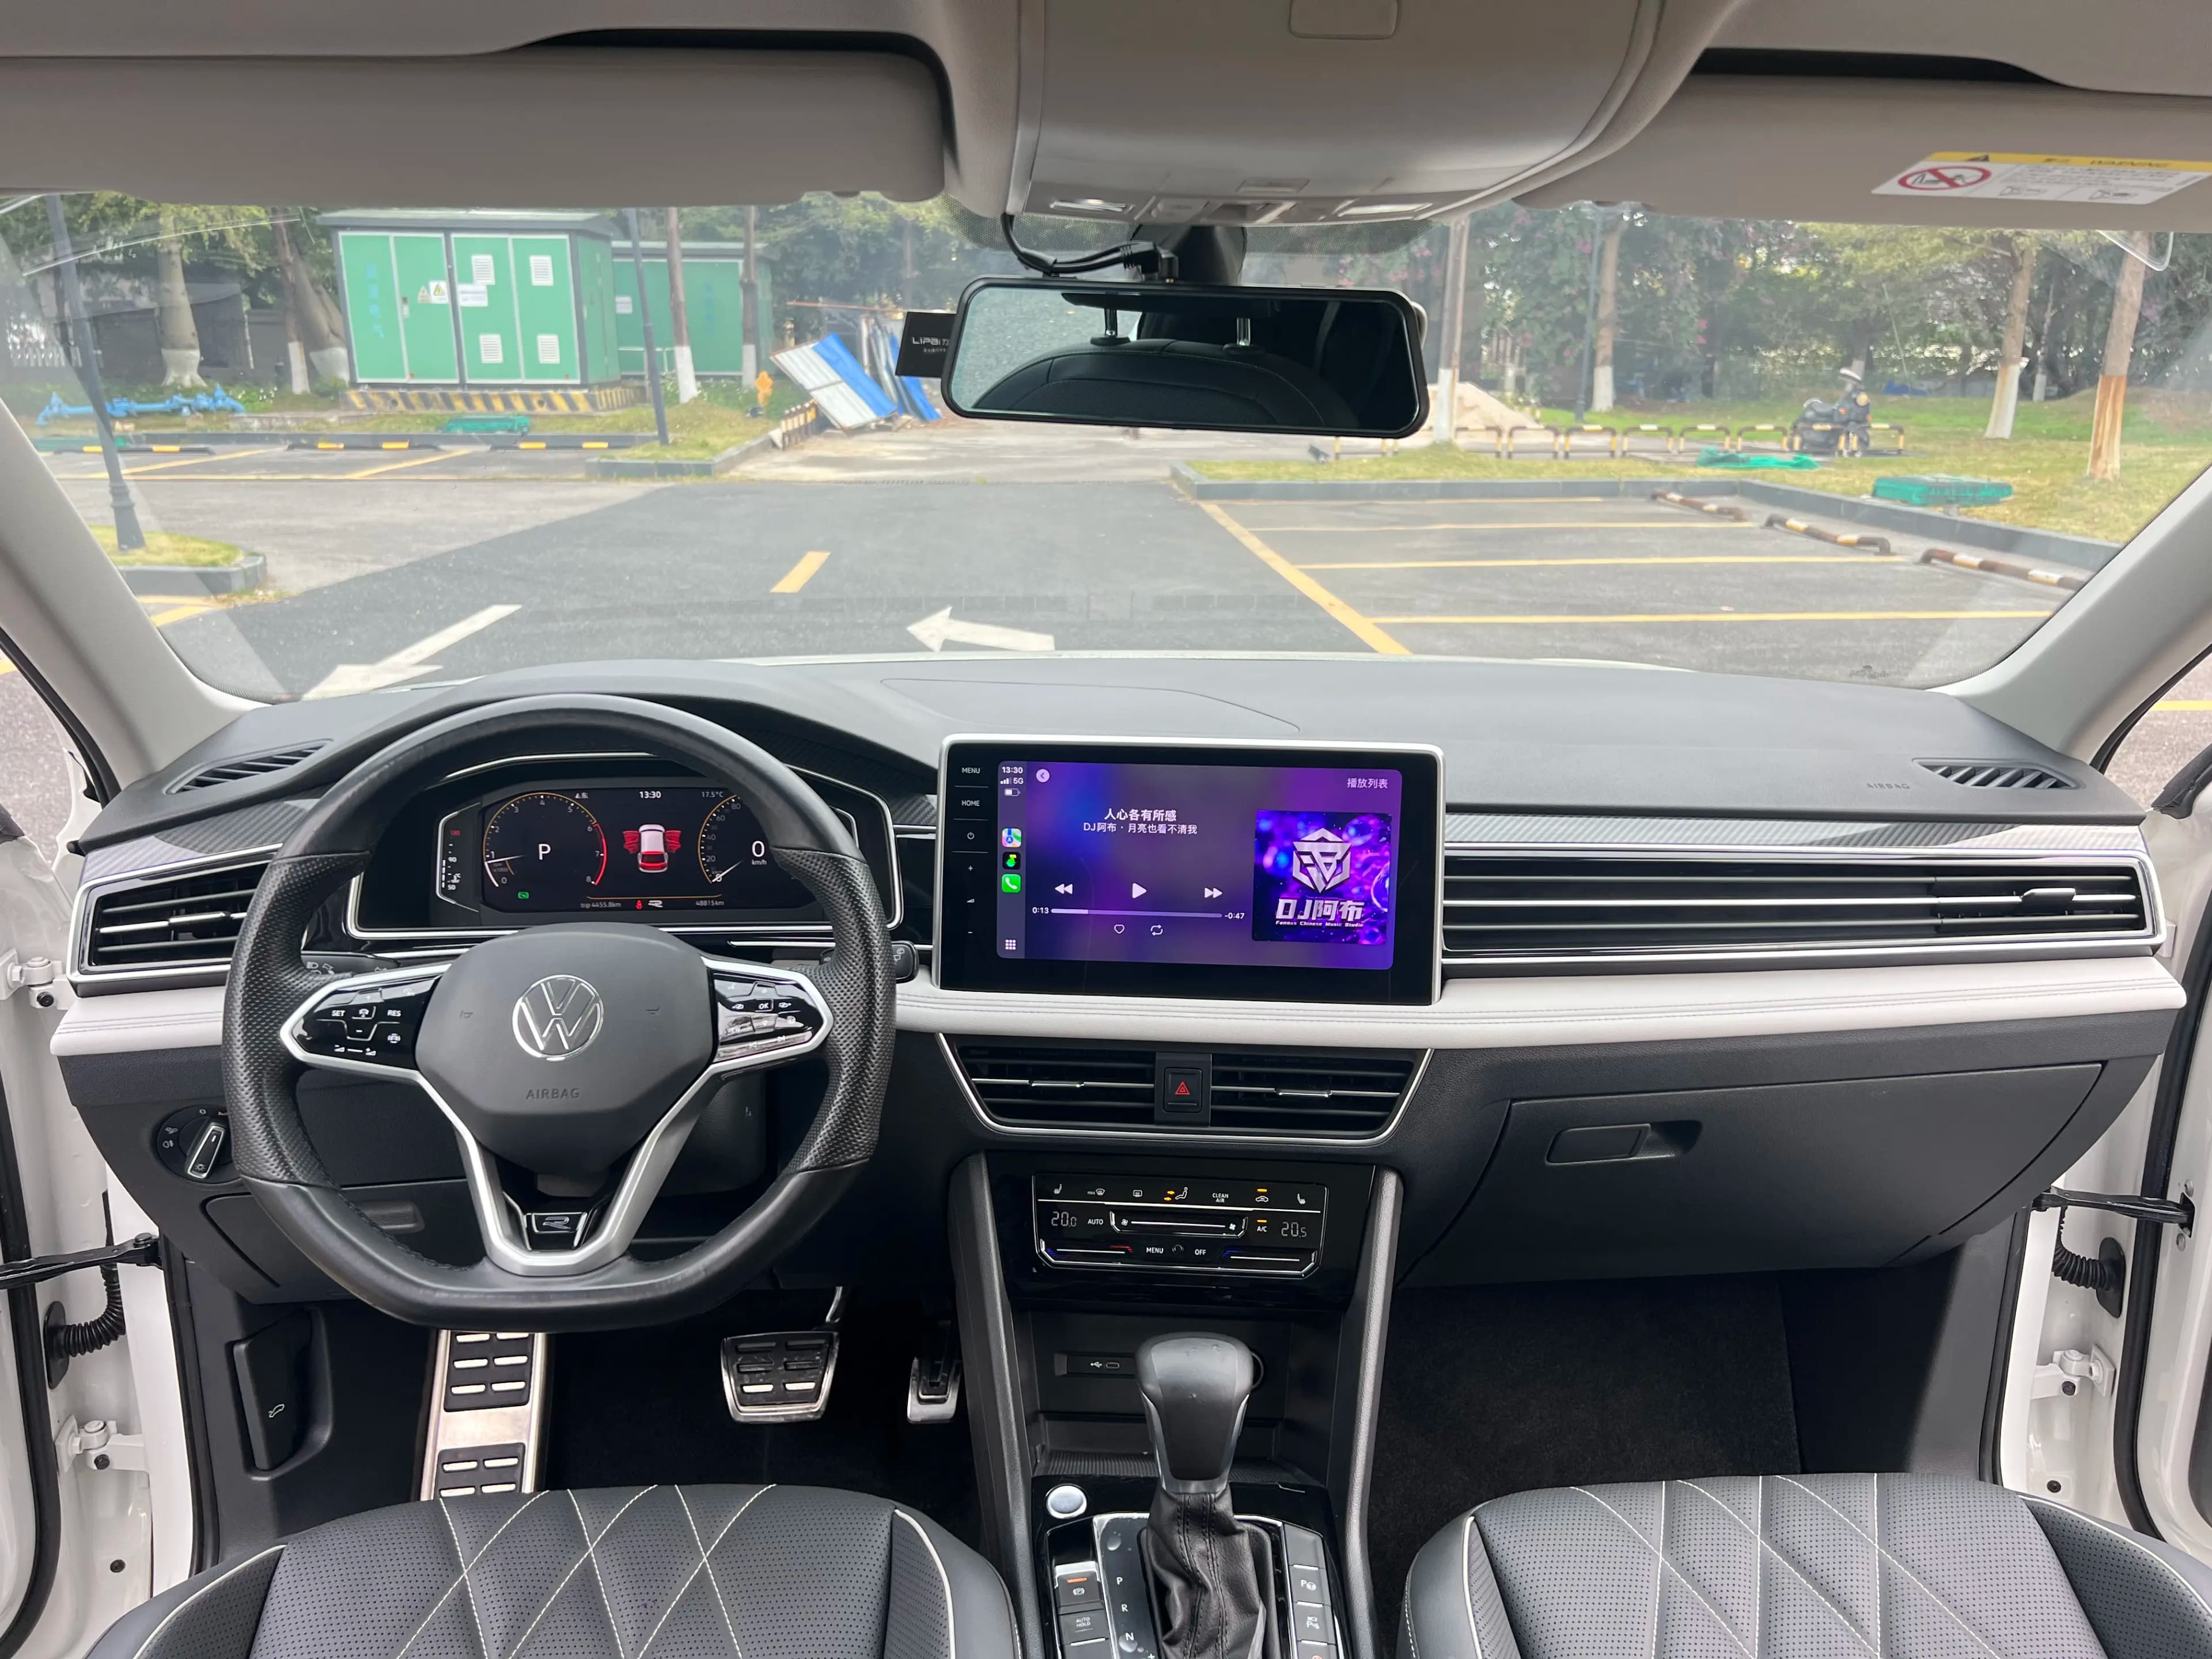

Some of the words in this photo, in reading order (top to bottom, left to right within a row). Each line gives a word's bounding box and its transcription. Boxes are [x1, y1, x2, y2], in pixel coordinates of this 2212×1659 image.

[1347, 778, 1388, 789] 播放列表
[1104, 808, 1177, 821] 人心各有所感
[538, 843, 551, 860] P
[752, 840, 765, 857] 0
[1276, 899, 1365, 921] DJ阿布
[526, 1088, 581, 1100] AIRBAG
[1116, 1577, 1123, 1585] P
[1121, 1604, 1128, 1612] R
[1125, 1633, 1134, 1641] N
